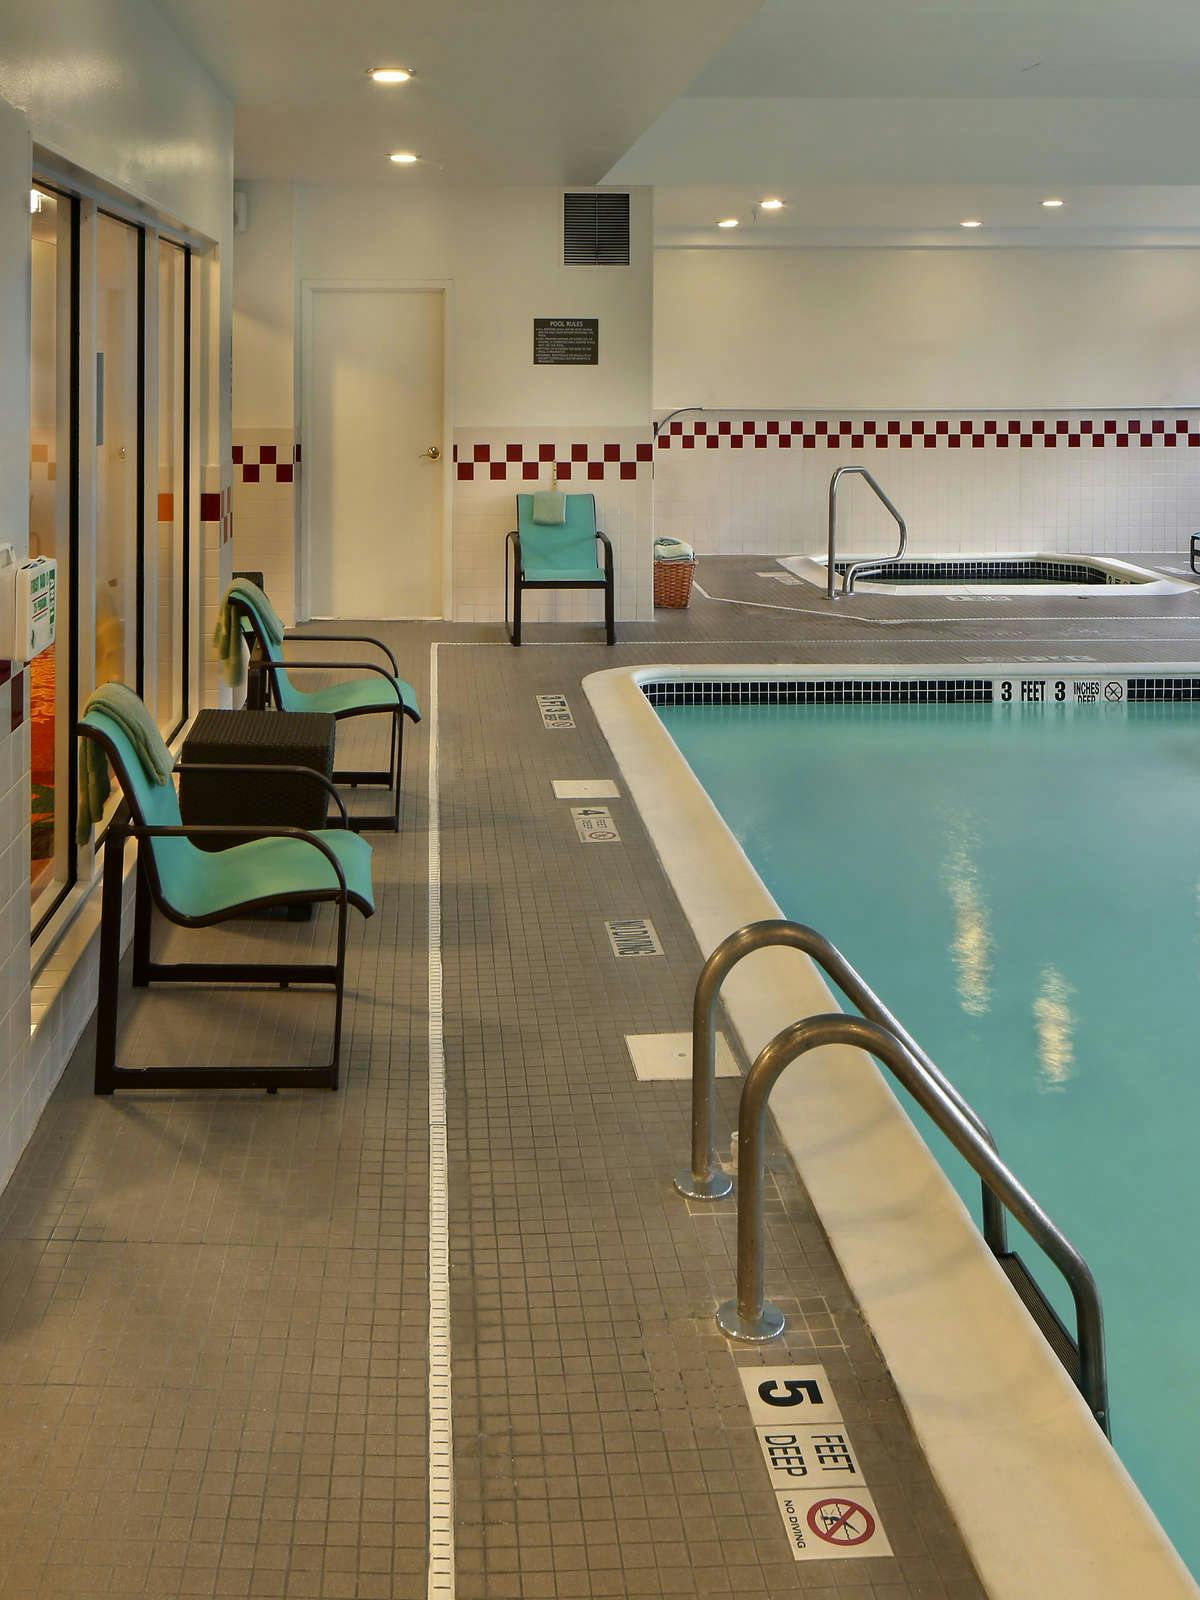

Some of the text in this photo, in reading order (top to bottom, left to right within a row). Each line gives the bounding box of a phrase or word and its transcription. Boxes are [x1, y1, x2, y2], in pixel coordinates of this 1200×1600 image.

[1001, 681, 1066, 701] 3 FEET 3
[1073, 682, 1099, 695] INCHES
[757, 1380, 824, 1407] 5
[764, 1435, 808, 1477] DEEP
[811, 1435, 856, 1474] FEET
[784, 1500, 806, 1549] NO DIVING
